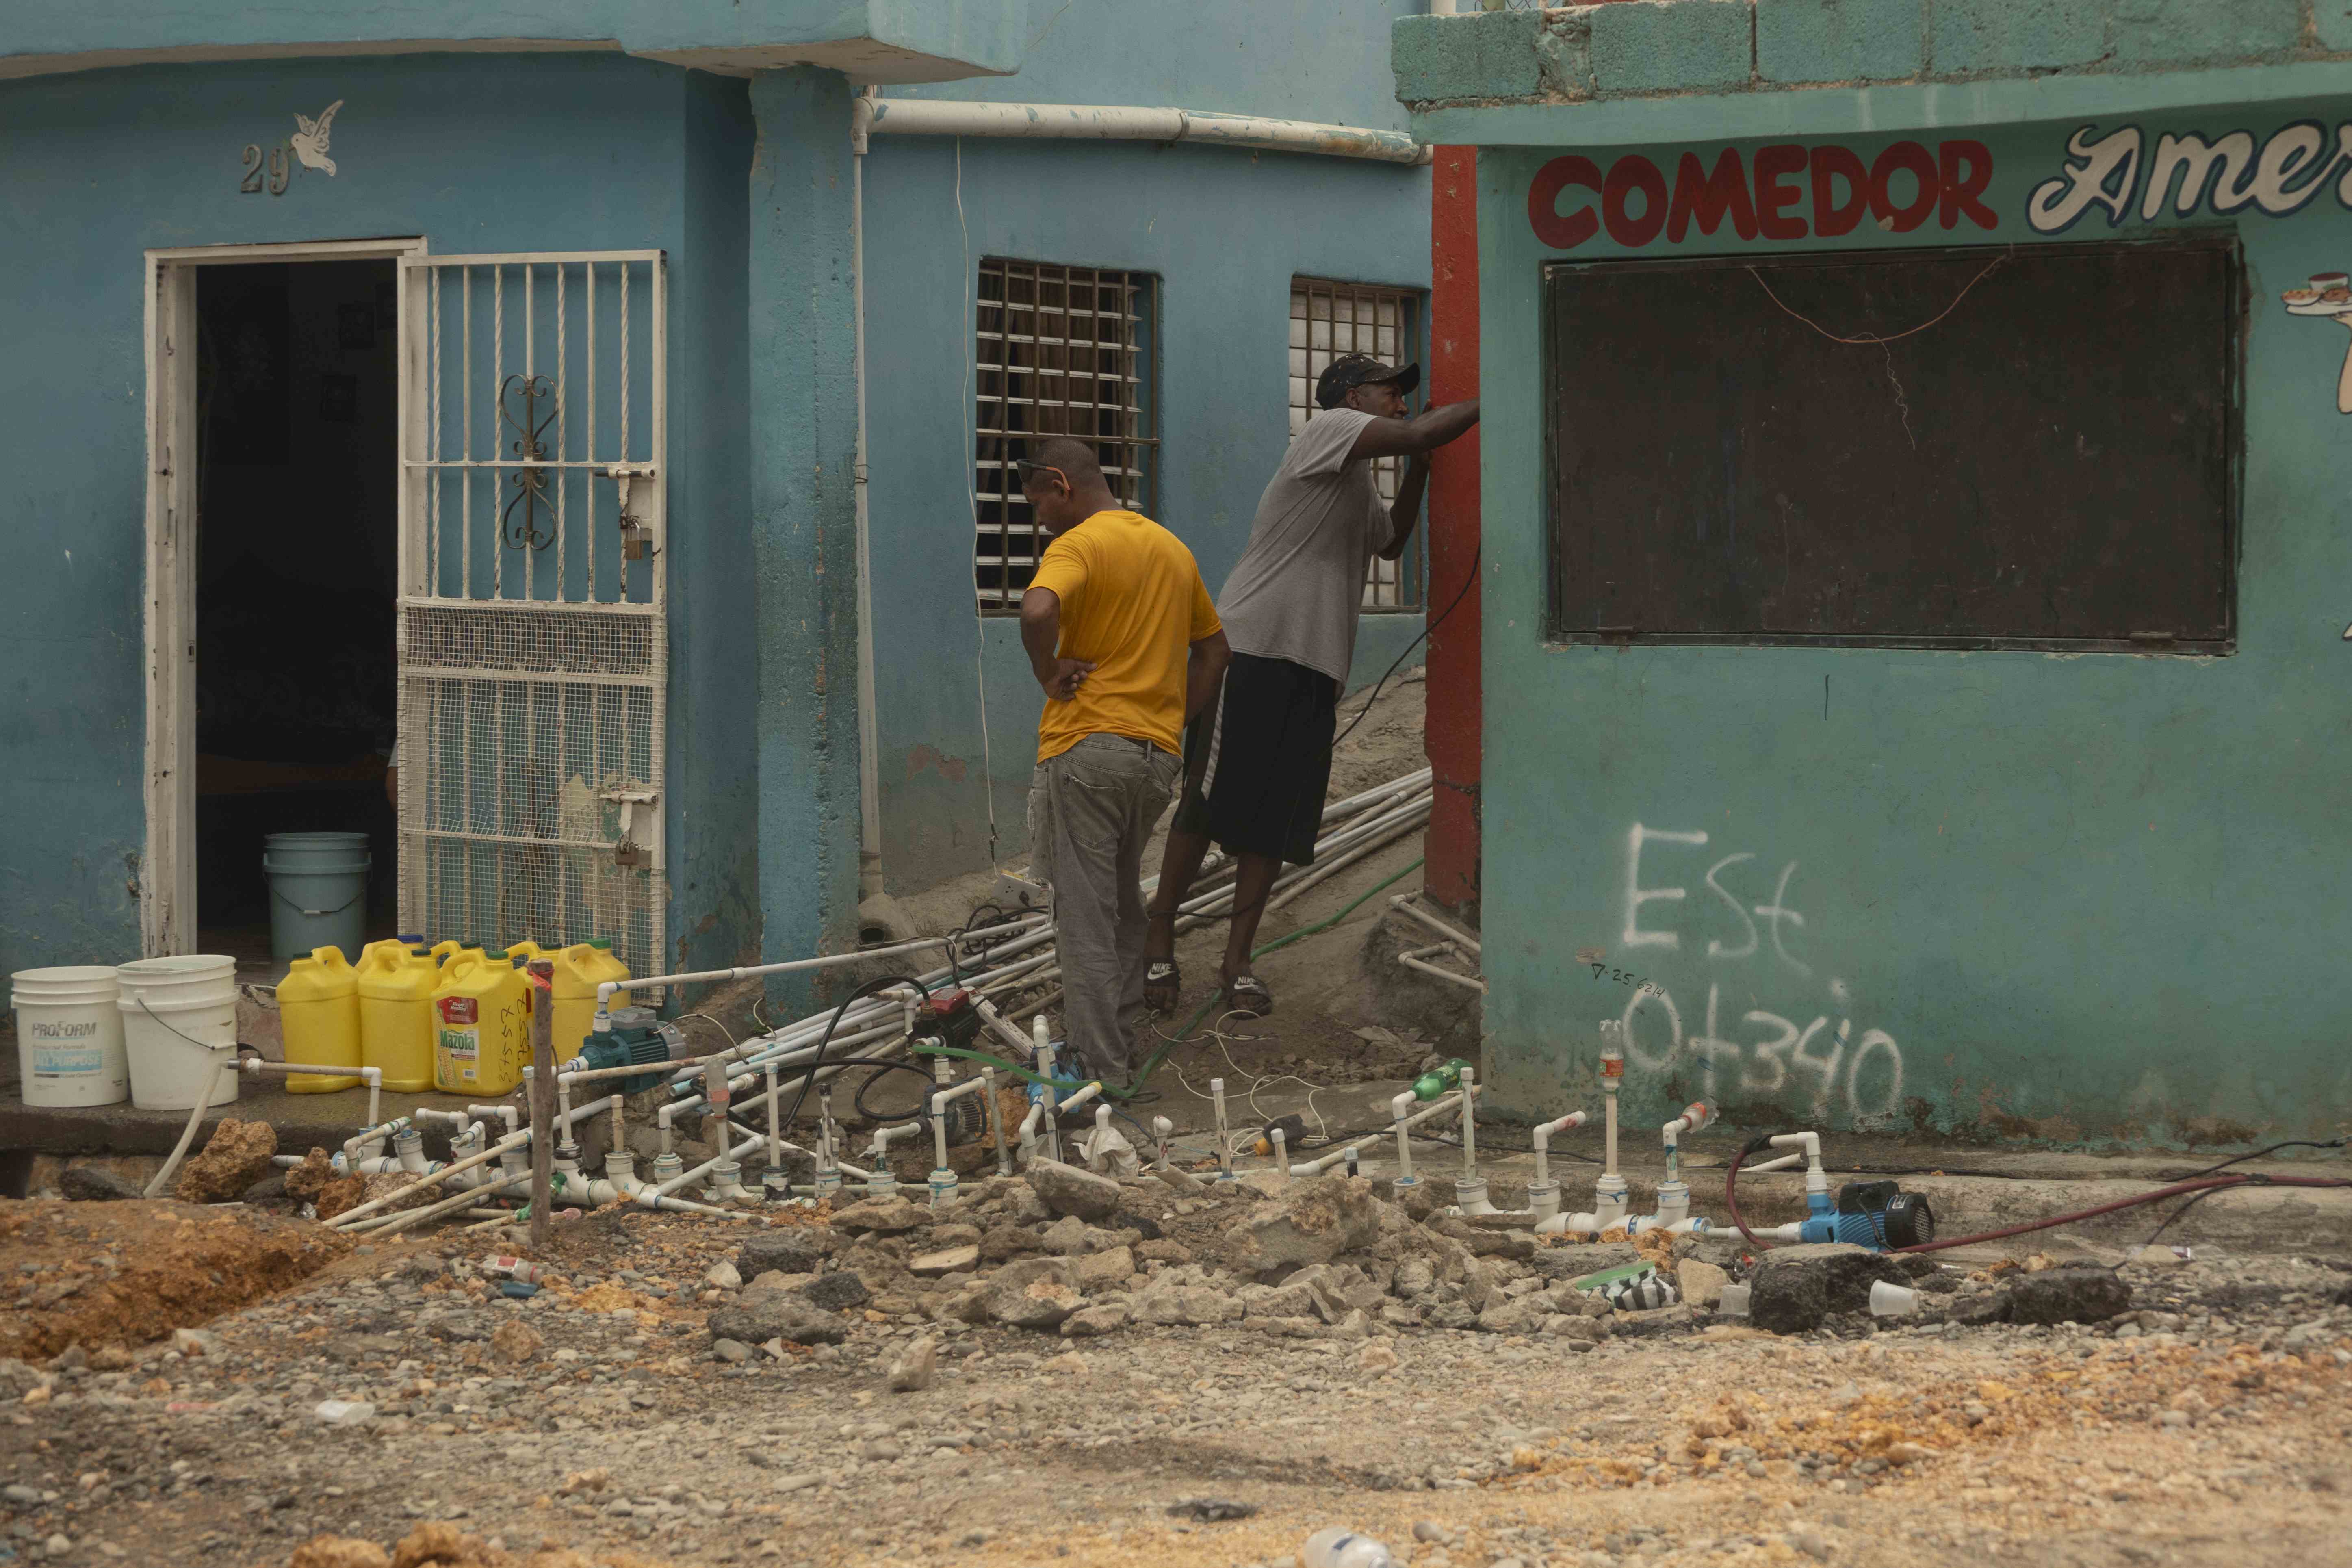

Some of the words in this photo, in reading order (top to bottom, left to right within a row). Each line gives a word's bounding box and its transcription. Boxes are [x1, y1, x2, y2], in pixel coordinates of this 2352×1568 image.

[240, 144, 290, 196] 29
[1528, 139, 1999, 249] COMEDOR
[1151, 963, 1172, 972] NIKE
[1238, 976, 1256, 985] NIKE
[440, 1030, 475, 1050] Mazola
